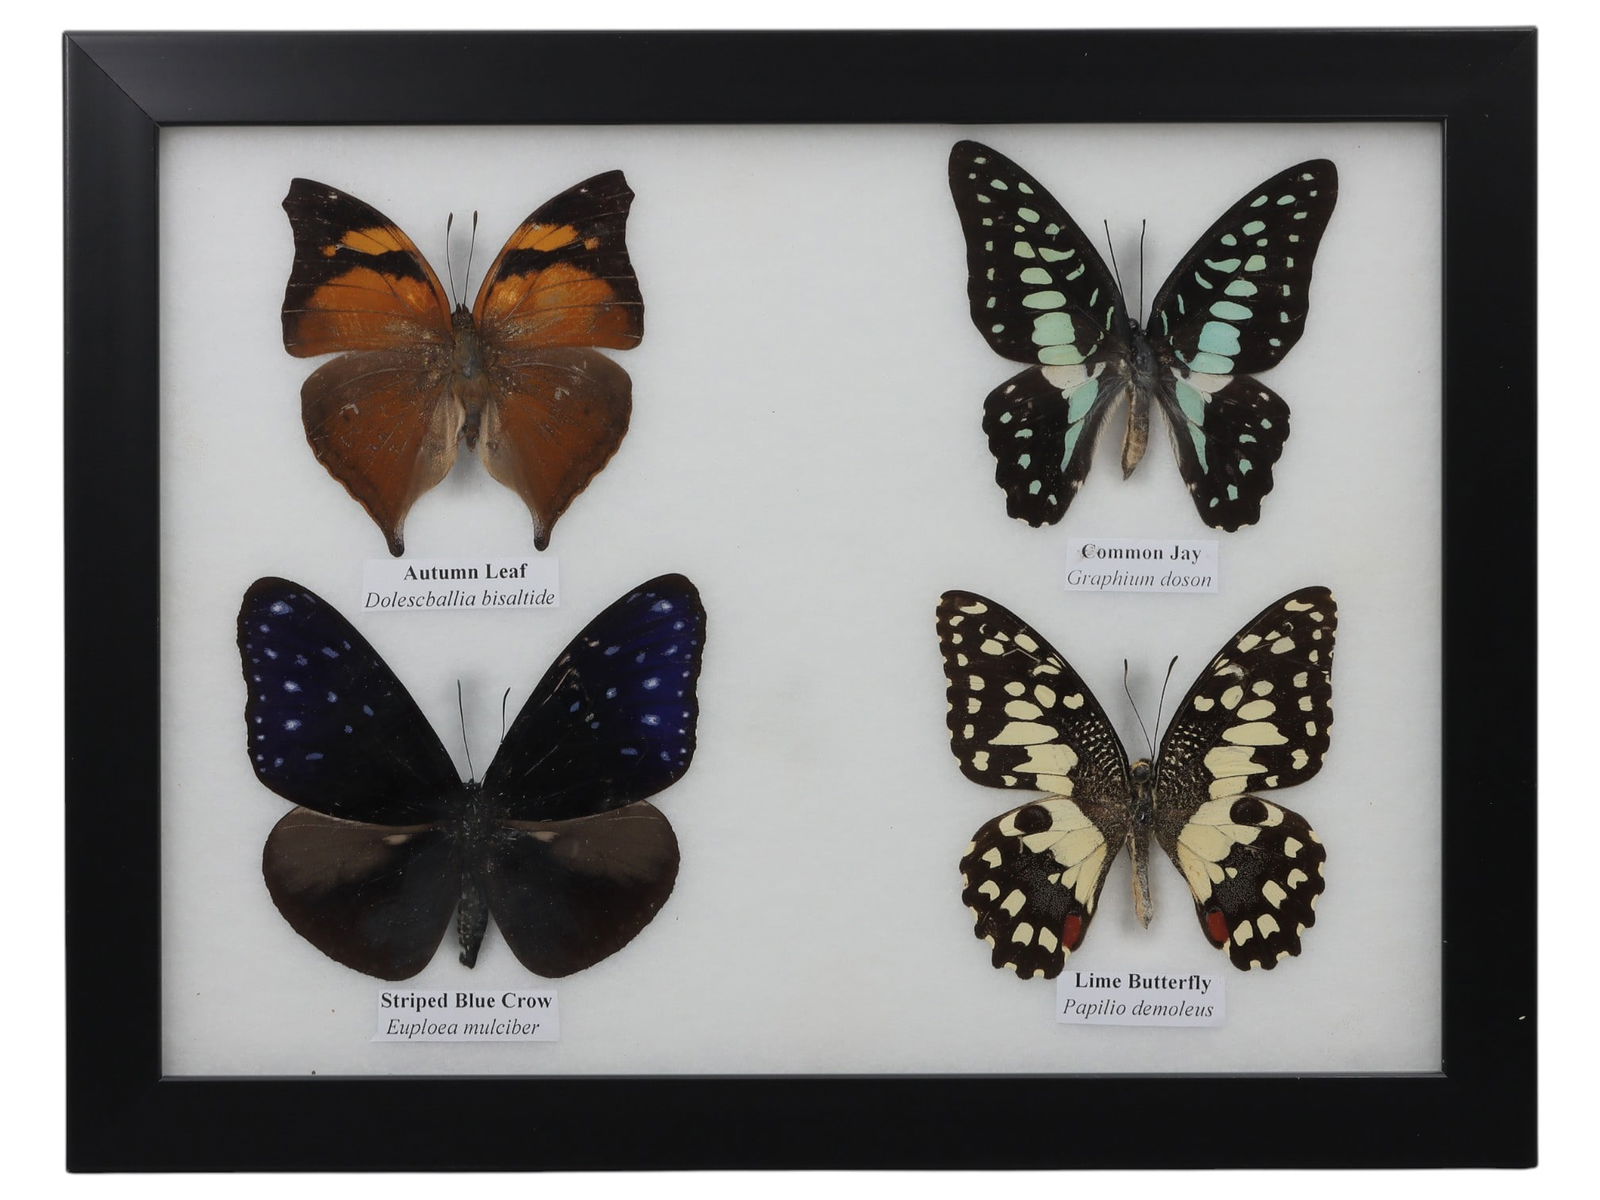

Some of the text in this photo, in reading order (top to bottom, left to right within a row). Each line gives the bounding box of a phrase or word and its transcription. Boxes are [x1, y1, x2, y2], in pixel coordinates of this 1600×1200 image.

[1081, 543, 1202, 565] Common Jay
[404, 562, 529, 581] Autumn Leaf
[1067, 569, 1212, 590] Graphium doson
[481, 588, 555, 606] bisaltide
[1075, 972, 1212, 995] Lime Butterfly
[381, 992, 553, 1013] Striped Blue Crow
[1063, 998, 1214, 1020] Papilio demoleus
[386, 1018, 540, 1040] Euploea mulciber
